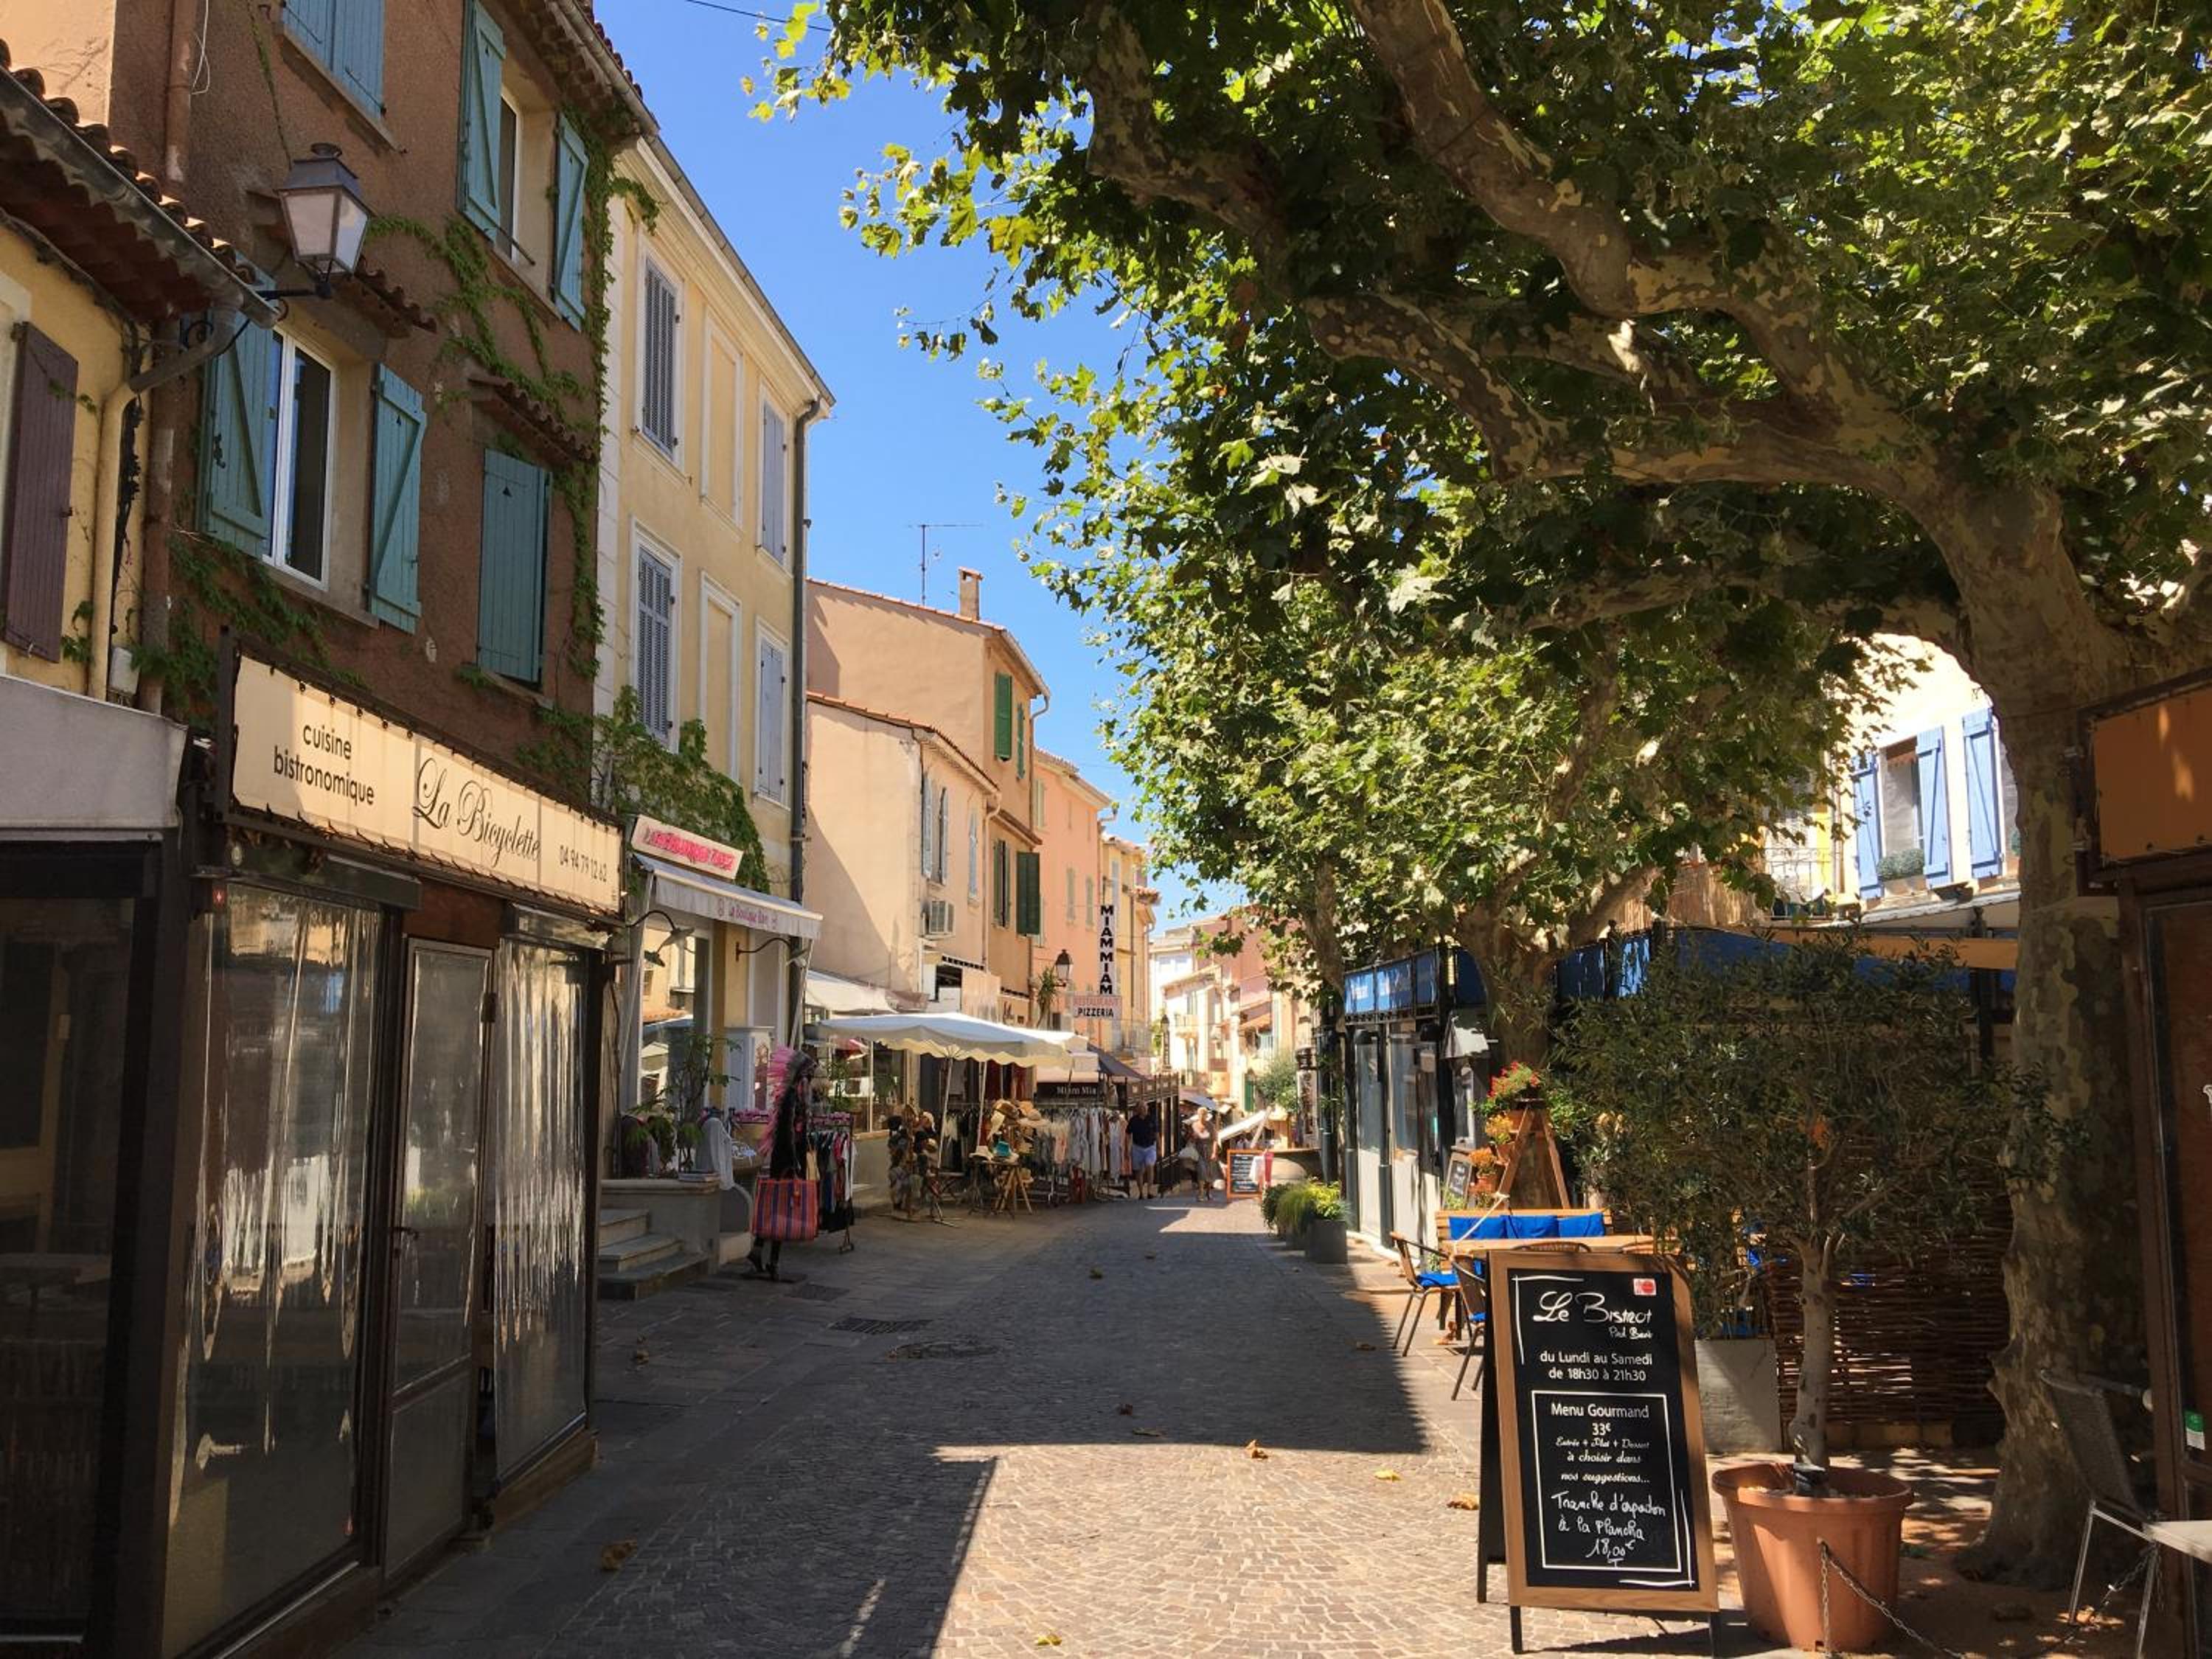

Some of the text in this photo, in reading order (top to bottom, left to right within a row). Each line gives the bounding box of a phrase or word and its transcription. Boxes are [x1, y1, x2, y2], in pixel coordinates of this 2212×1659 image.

[303, 725, 352, 760] cuisine
[274, 745, 375, 806] bistronomique
[412, 757, 541, 868] La Bicyclette
[560, 845, 568, 867] 04
[571, 849, 579, 872] 94
[580, 854, 589, 874] 79
[591, 858, 598, 880] 12
[1100, 905, 1114, 948] MIAM
[1099, 952, 1113, 995] MIAM
[1077, 1007, 1114, 1018] PIZZERIA
[1533, 1291, 1573, 1322] Le
[1540, 1350, 1652, 1365] du Lundi au Samedi
[1548, 1367, 1646, 1381] de 18h30 à 21h30
[1551, 1402, 1649, 1418] Menu Gourmand
[1592, 1422, 1612, 1436] 33€
[1591, 1437, 1610, 1447] Plat
[1567, 1450, 1641, 1464] à choisir dans
[1561, 1472, 1579, 1481] nos
[1551, 1490, 1604, 1512] Tranche
[1558, 1514, 1570, 1531] à
[1576, 1514, 1590, 1534] la
